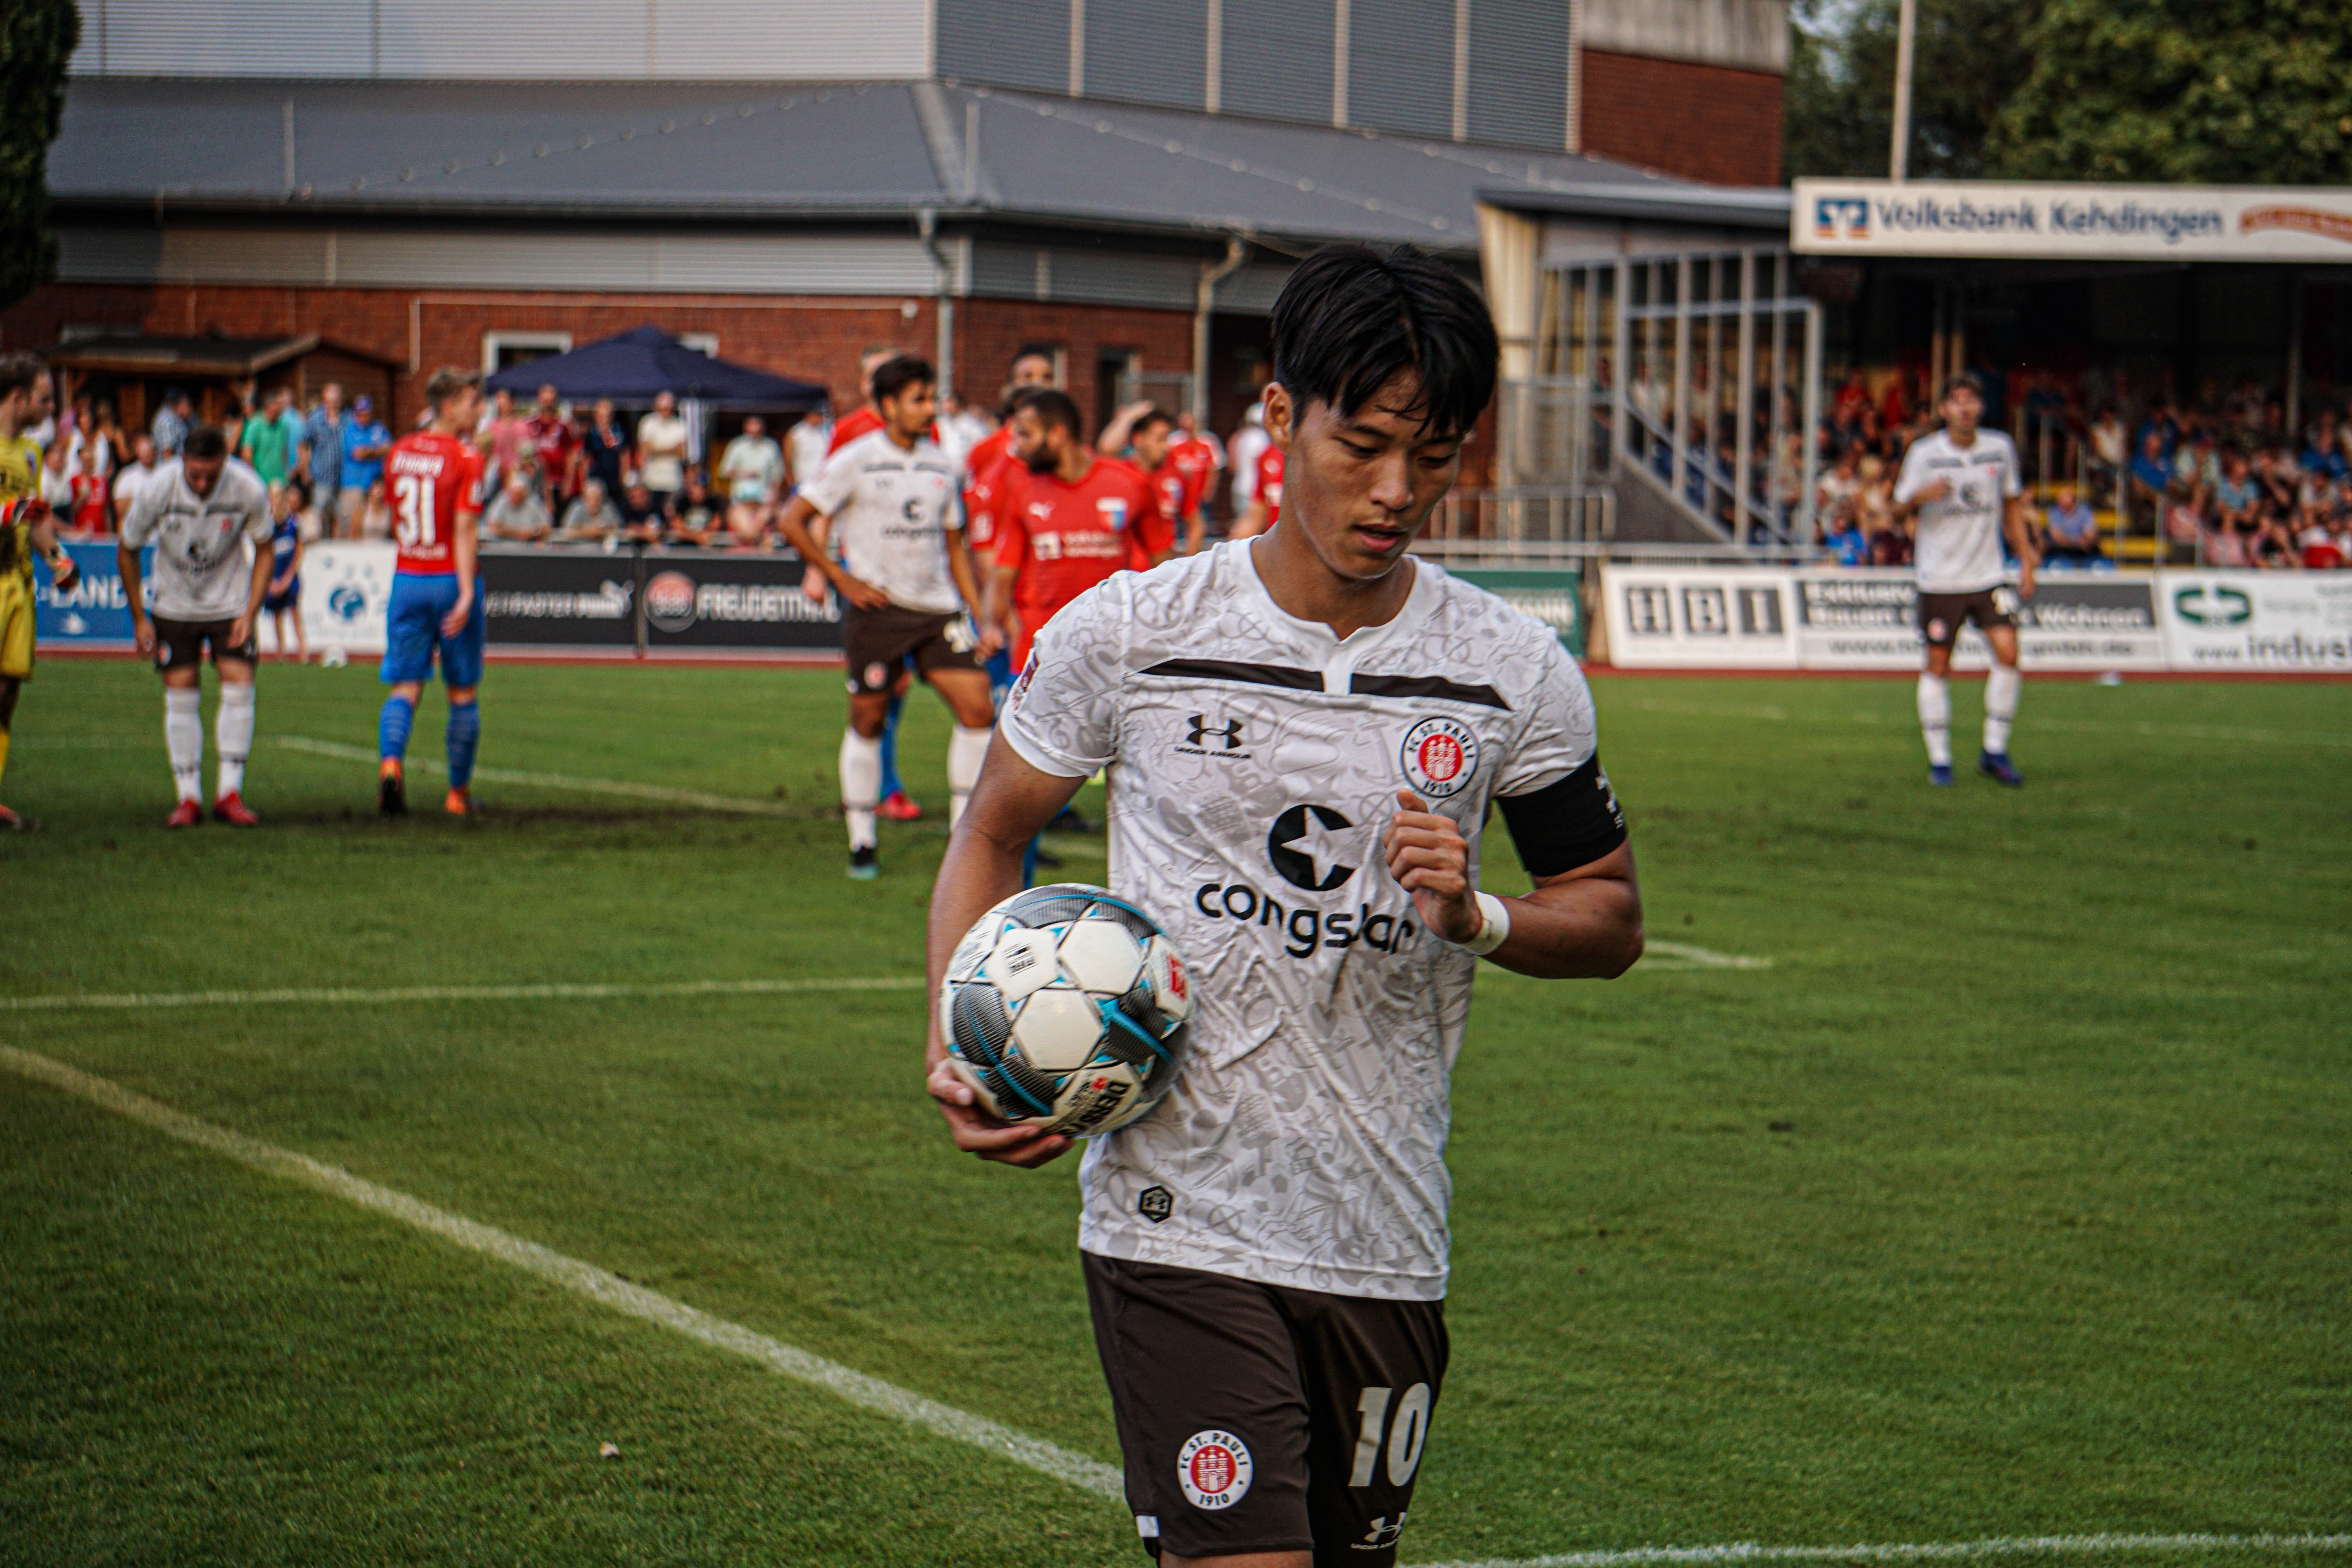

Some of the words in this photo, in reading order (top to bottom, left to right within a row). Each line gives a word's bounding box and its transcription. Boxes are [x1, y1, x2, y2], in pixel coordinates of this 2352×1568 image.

[1876, 196, 2040, 232] Volksbank
[2049, 199, 2224, 244] Kehdingen
[394, 473, 436, 548] 31
[1628, 587, 1780, 633] HBI
[1406, 737, 1421, 752] FC
[1443, 722, 1475, 759] PAULI
[1179, 1454, 1190, 1469] FC
[1189, 1436, 1208, 1451] ST.
[1212, 1433, 1249, 1466] PAULI
[1348, 1383, 1431, 1487] 10
[1199, 1493, 1230, 1506] 1910
